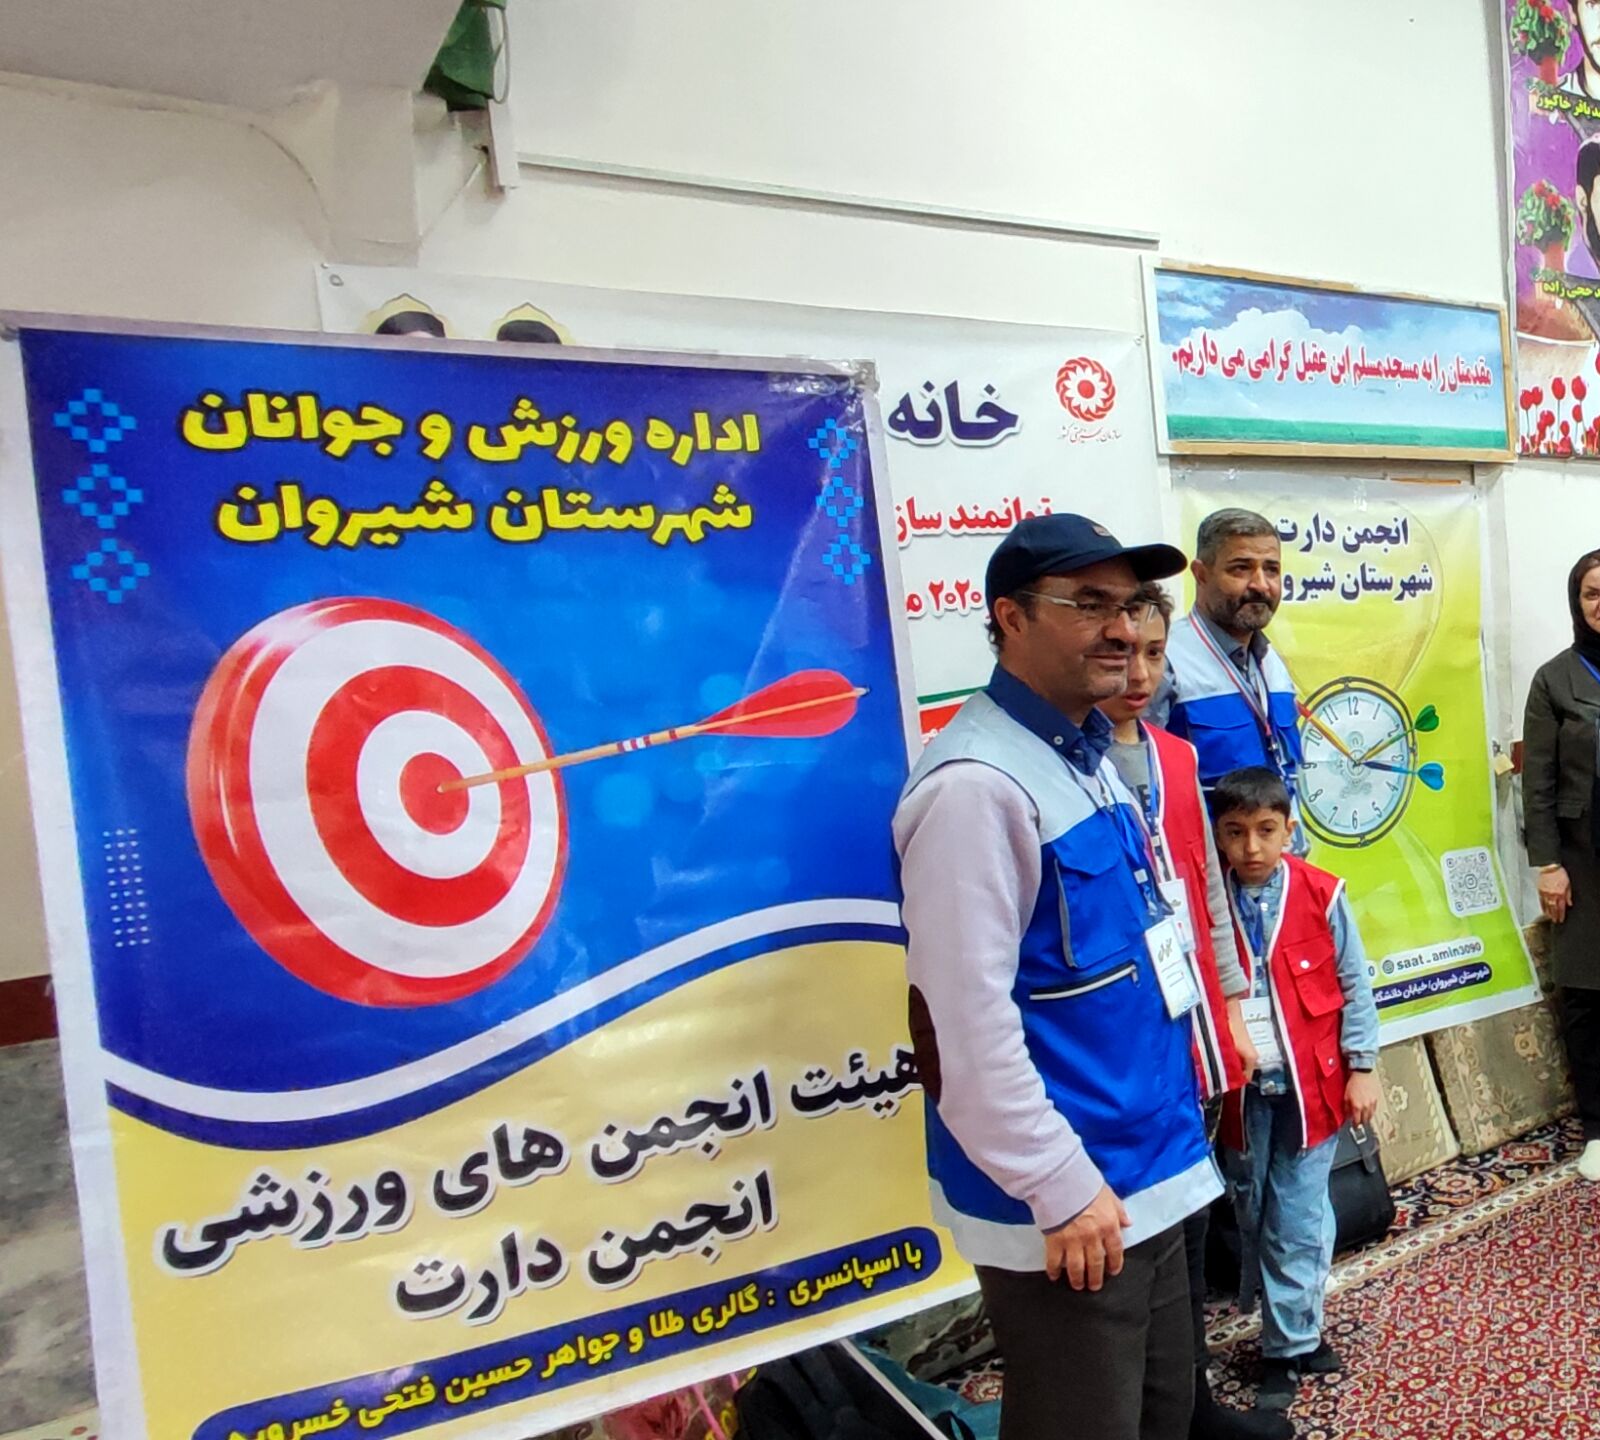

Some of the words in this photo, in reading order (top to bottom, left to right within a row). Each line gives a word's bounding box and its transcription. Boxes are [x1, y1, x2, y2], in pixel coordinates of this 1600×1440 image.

[1221, 348, 1245, 378] می
[1248, 338, 1292, 382] گرامی
[1296, 341, 1328, 381] عقیل
[1330, 345, 1350, 385] ابن
[181, 392, 404, 458] جوانان
[467, 397, 635, 465] ورزش
[887, 380, 1020, 441] خانه
[419, 412, 452, 460] و
[645, 411, 761, 467] اداره
[217, 479, 474, 547] شیروان
[489, 483, 753, 546] شهرستان
[1275, 512, 1336, 552] دارت
[1342, 516, 1409, 553] انجمن
[1282, 562, 1336, 601] شیرو
[1340, 561, 1433, 601] شهرستان
[1347, 695, 1360, 716] 12
[1352, 810, 1359, 830] 6
[790, 1048, 923, 1113] هیئت
[590, 1069, 773, 1178] انجمن
[432, 1122, 565, 1212] های
[162, 1169, 407, 1270] ورزشی
[588, 1169, 774, 1284] انجمن
[395, 1231, 564, 1320] دارت
[788, 1246, 900, 1307] اسپانسری
[904, 1242, 922, 1270] با
[649, 1308, 685, 1339] طلا
[691, 1282, 761, 1335] گالری
[539, 1331, 621, 1379] جواهر
[628, 1325, 645, 1353] و
[357, 1374, 437, 1430] فتحی
[444, 1355, 533, 1403] حسین
